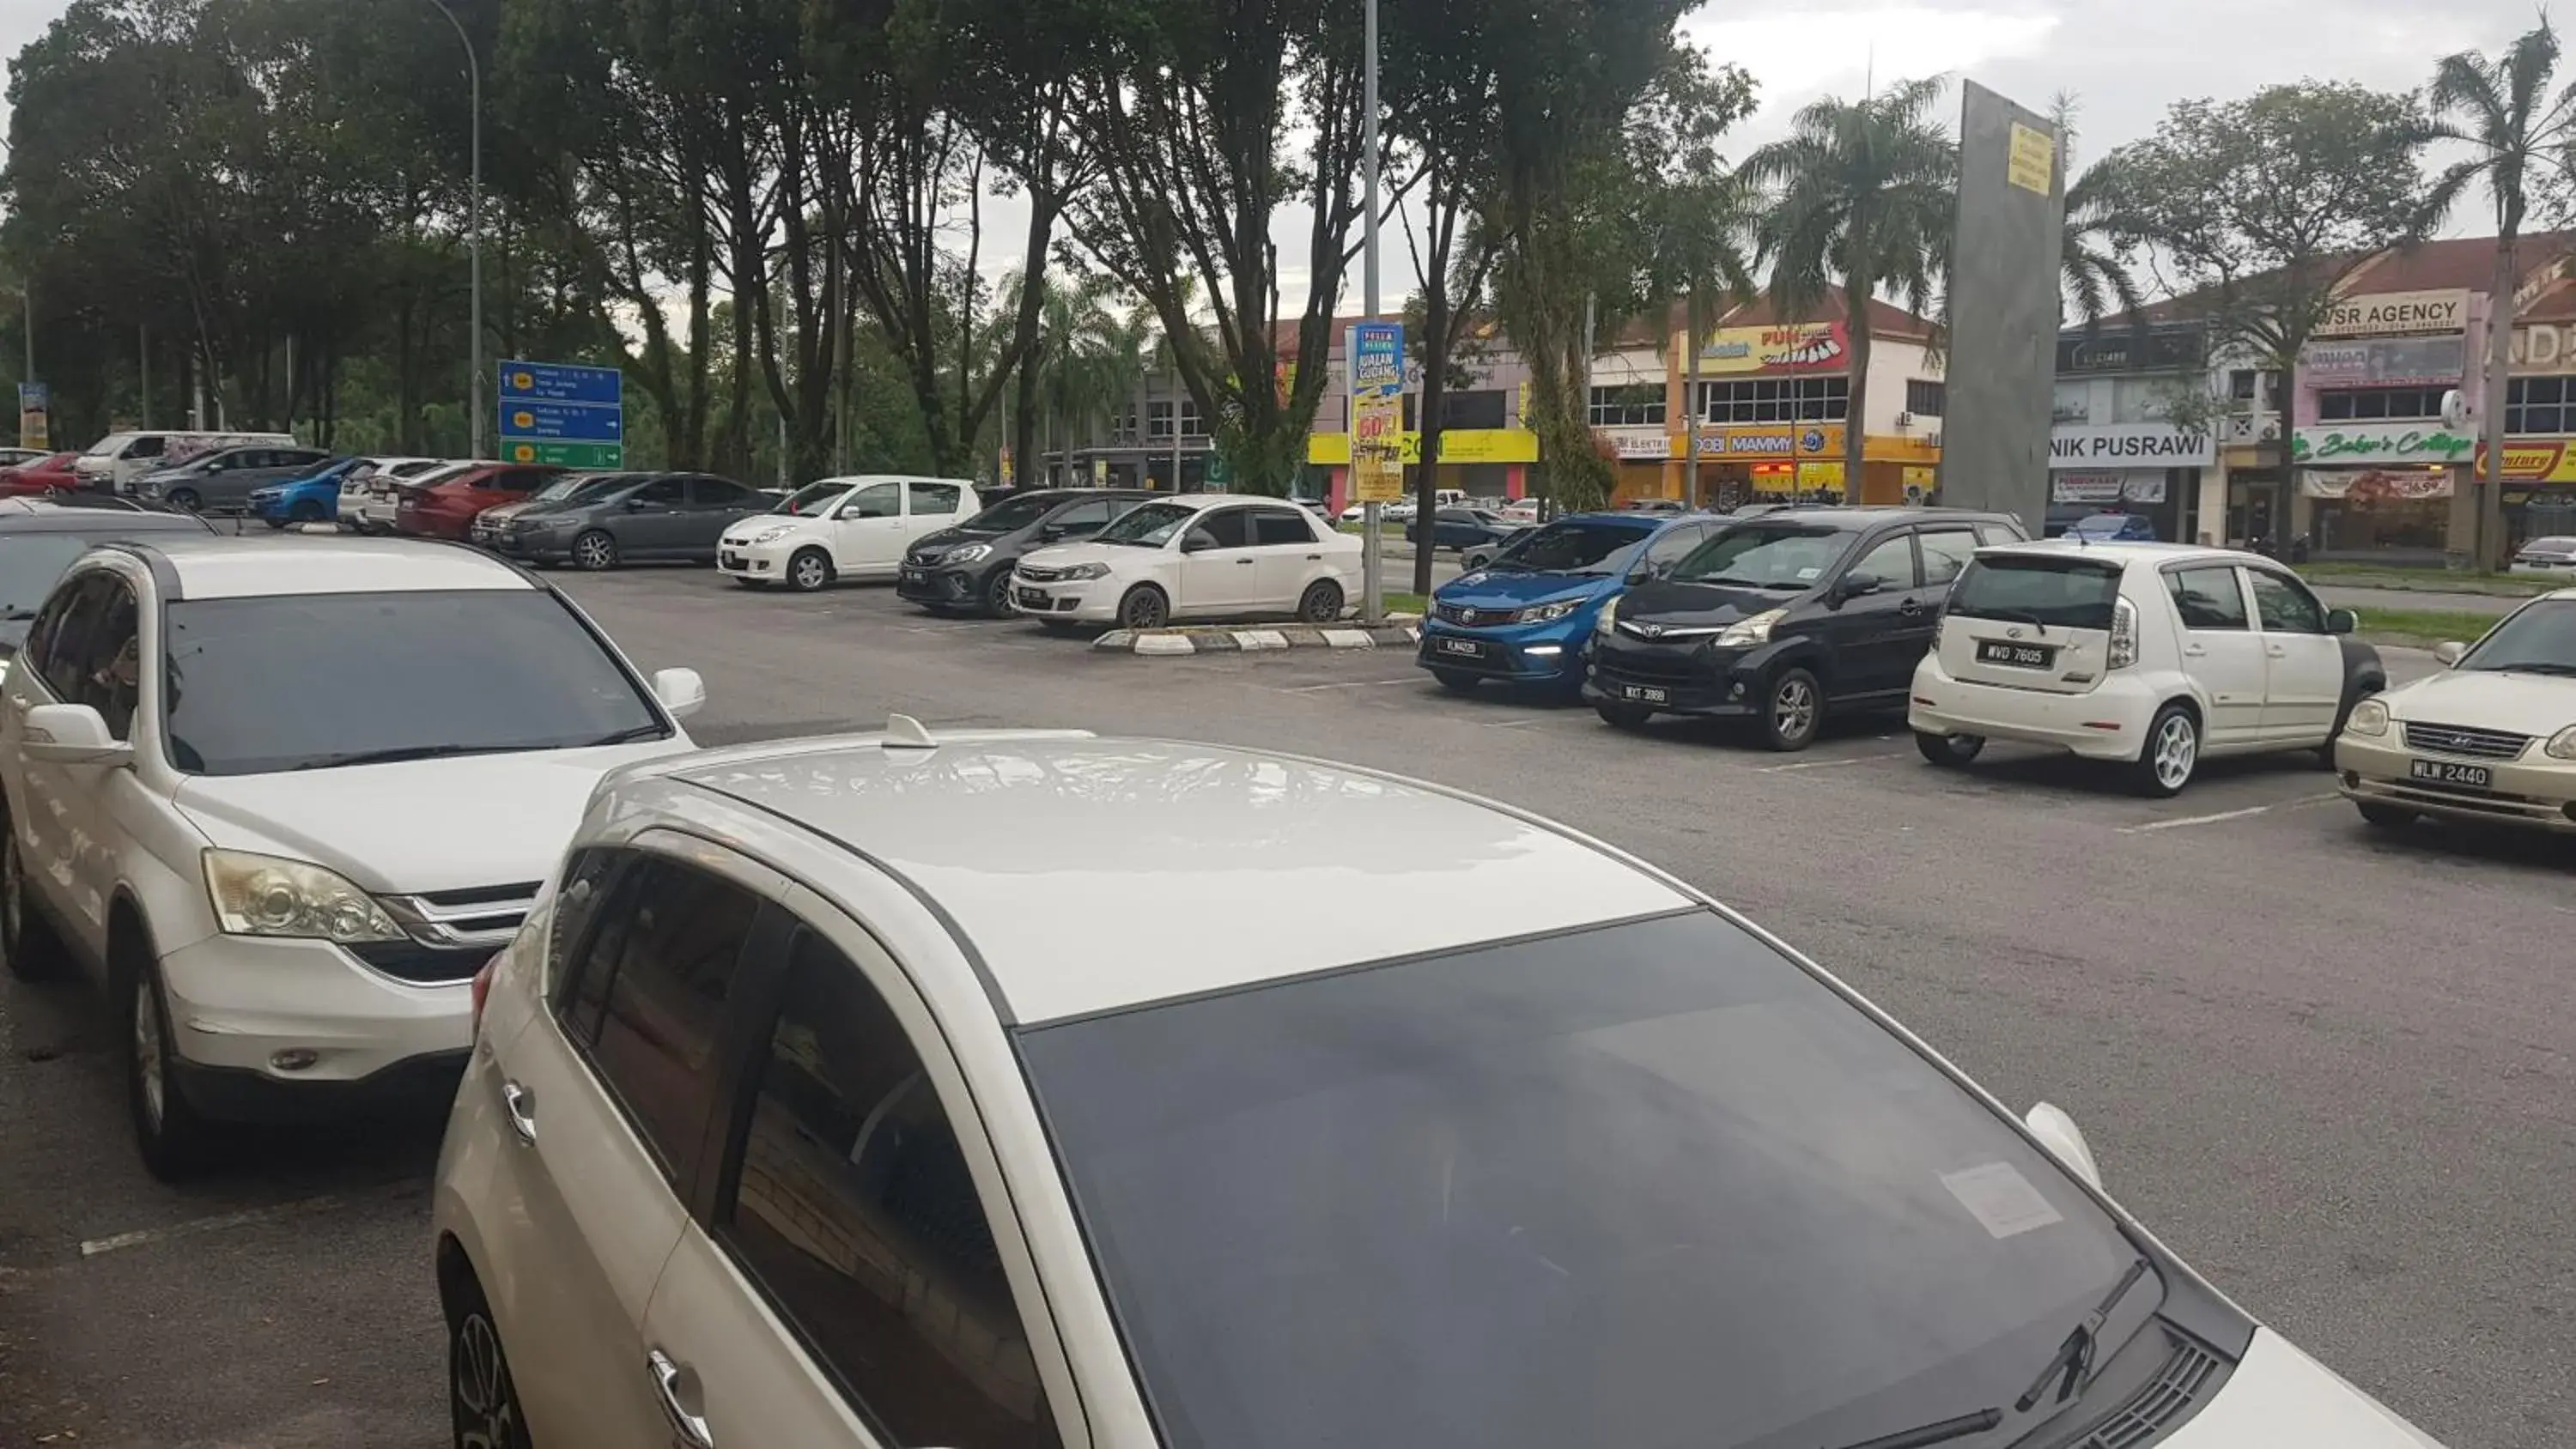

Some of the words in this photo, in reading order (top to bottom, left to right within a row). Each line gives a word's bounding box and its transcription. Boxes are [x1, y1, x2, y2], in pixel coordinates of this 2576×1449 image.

[2367, 302, 2457, 323] AGENCY
[1731, 436, 1792, 452] MAMMY
[2093, 435, 2204, 457] PUSRAWI
[2413, 760, 2442, 779] WLW
[2445, 765, 2487, 785] 2440
